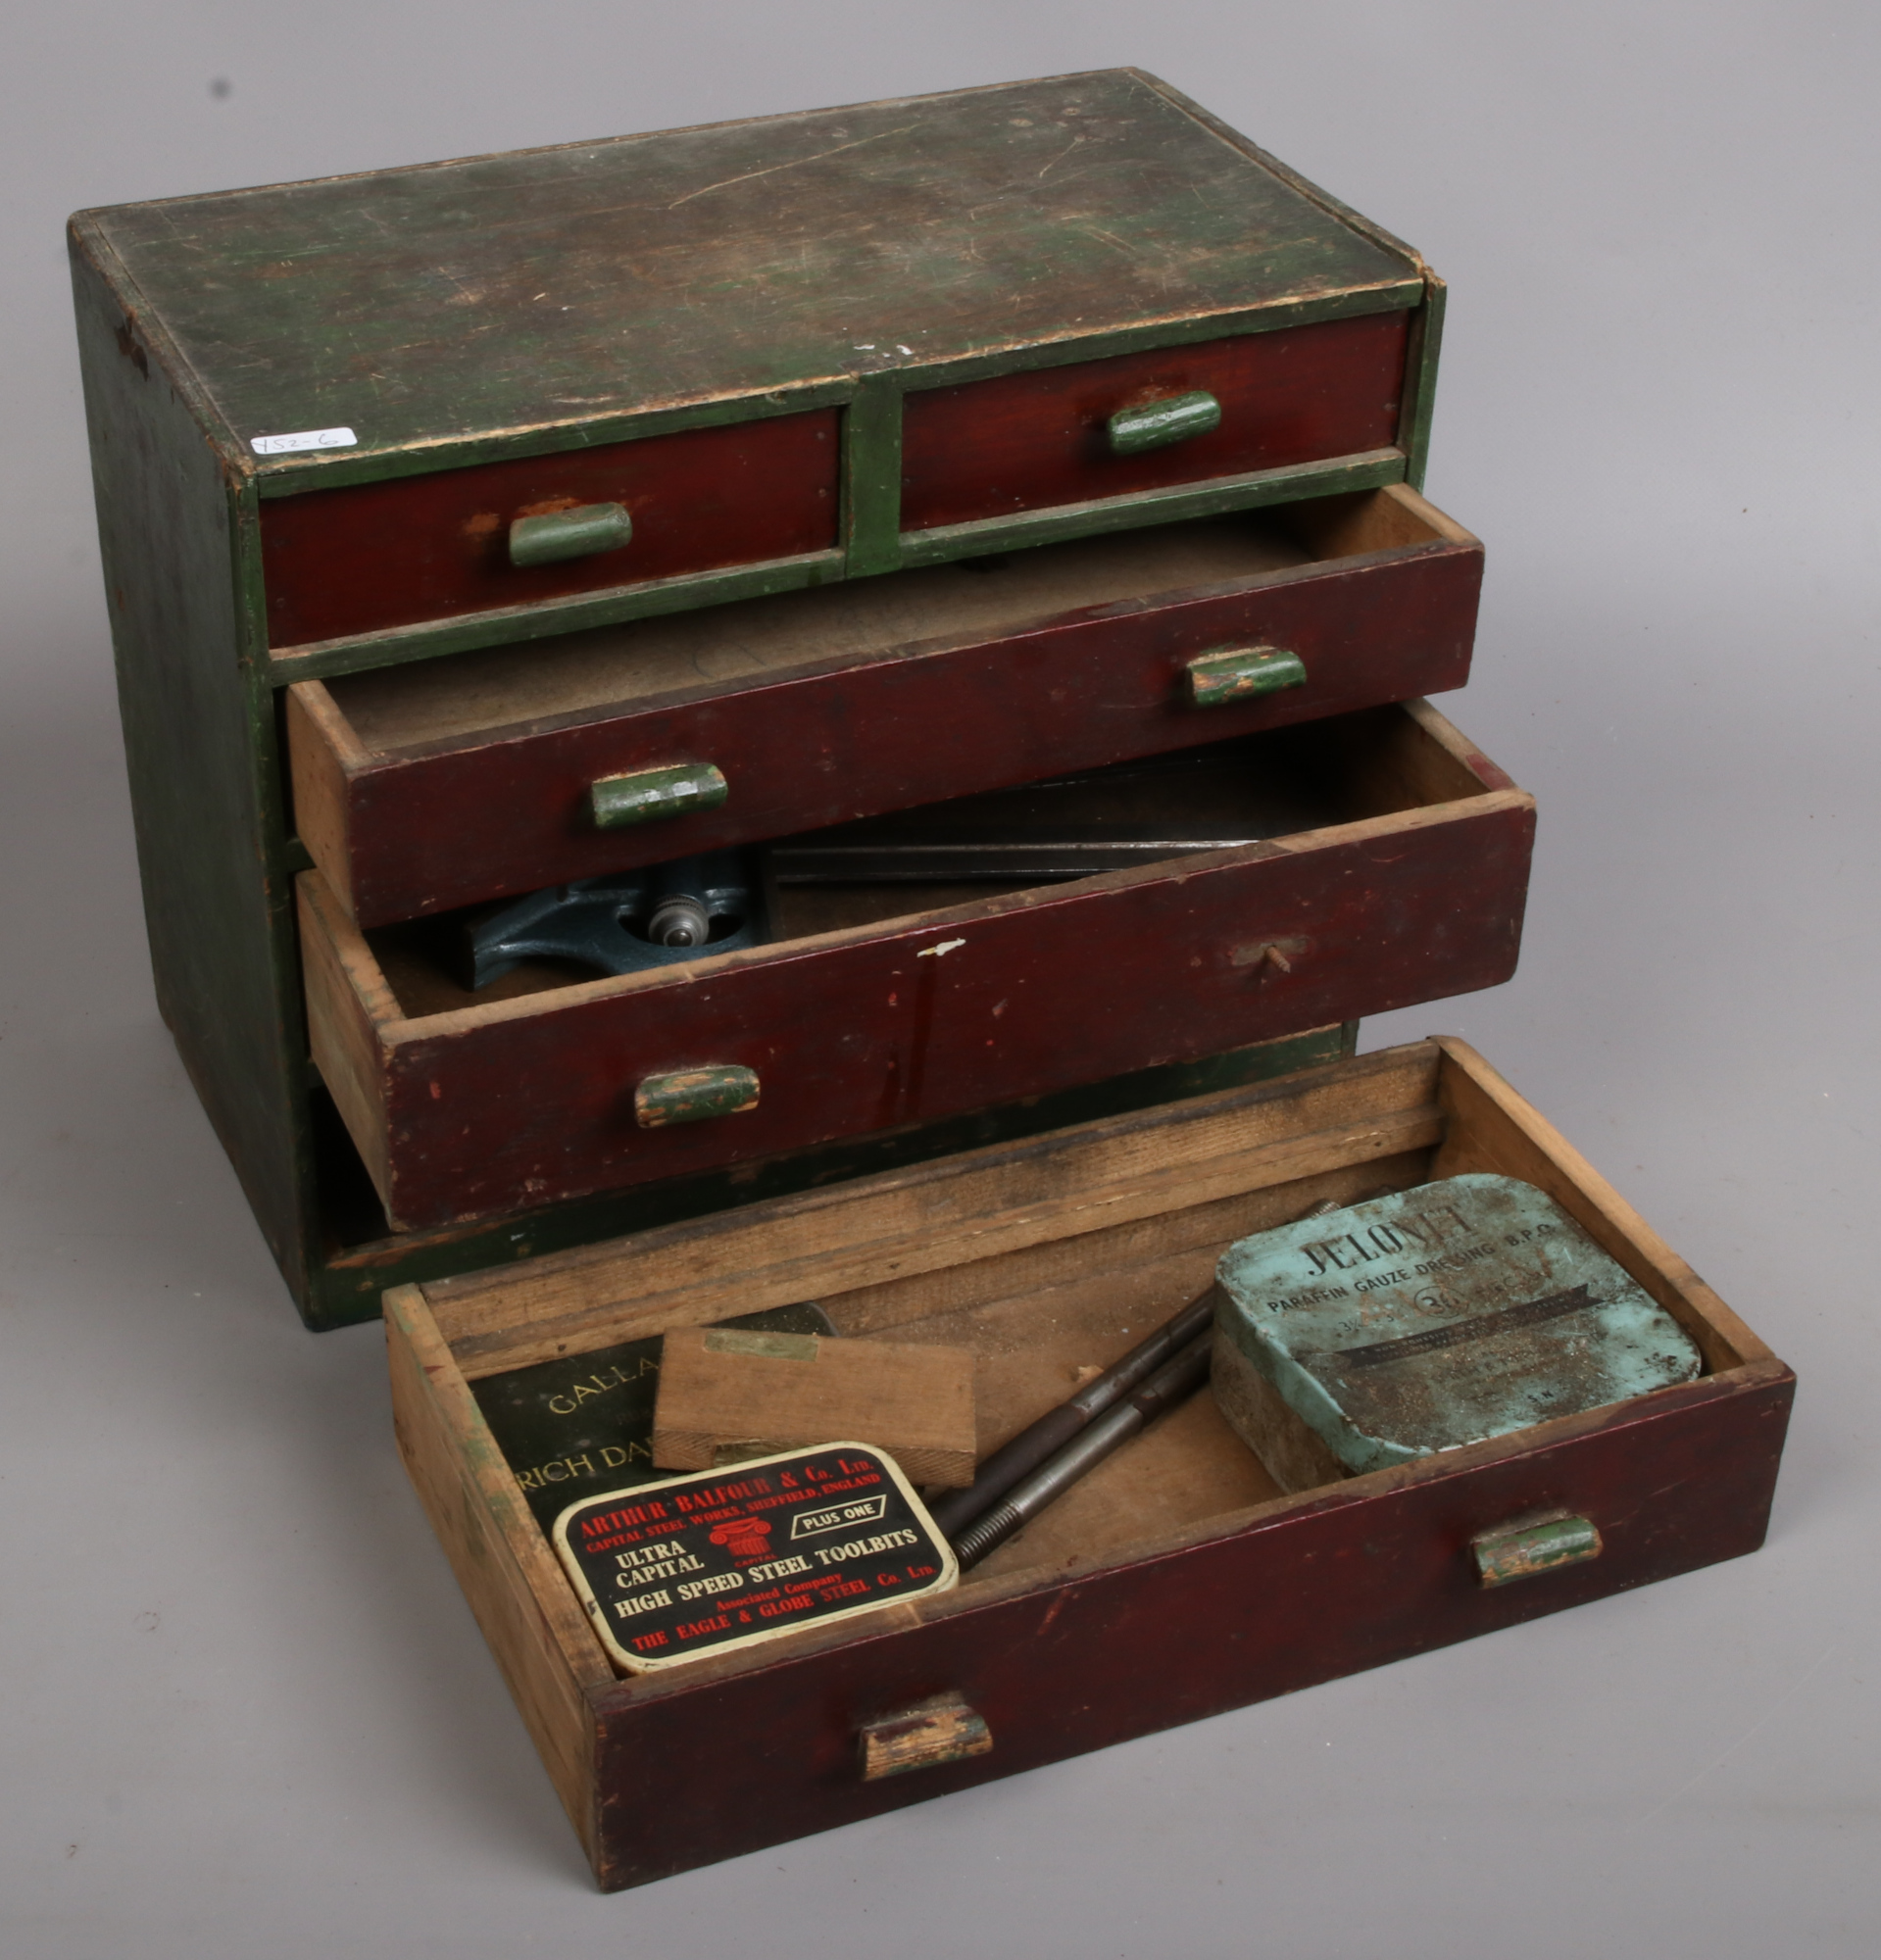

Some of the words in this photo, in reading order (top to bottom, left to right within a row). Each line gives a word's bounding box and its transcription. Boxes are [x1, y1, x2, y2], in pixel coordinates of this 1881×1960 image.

[1266, 1286, 1350, 1312] PARAFFIN
[1354, 1269, 1411, 1293] GAUZE
[515, 1454, 595, 1491] RICH
[599, 1437, 654, 1468] DA
[580, 1501, 668, 1538] ARTHUR
[674, 1478, 771, 1513] BALFOUR
[780, 1472, 799, 1488] &
[805, 1465, 833, 1482] Co.
[586, 1531, 645, 1553] CAPITAL
[645, 1519, 686, 1537] STEEL
[746, 1488, 821, 1512] SHEFFIELD,
[821, 1473, 881, 1494] ENGLAND
[803, 1512, 840, 1530] PLUS
[843, 1503, 875, 1520] ONE
[614, 1590, 673, 1618] HIGH
[677, 1572, 744, 1600] SPEED
[748, 1555, 813, 1583] STEEL
[815, 1528, 918, 1565] TOOLBITS
[615, 1541, 686, 1568] ULTRA
[616, 1554, 705, 1589] CAPITAL
[734, 1553, 778, 1568] CAPITAL
[631, 1630, 669, 1651] THE
[675, 1614, 731, 1640] EAGLE
[738, 1609, 753, 1623] &
[759, 1593, 815, 1617] GLOBE
[820, 1579, 871, 1602] STEEL
[876, 1572, 902, 1587] Co.
[716, 1588, 780, 1611] Associated
[784, 1573, 842, 1595] Company
